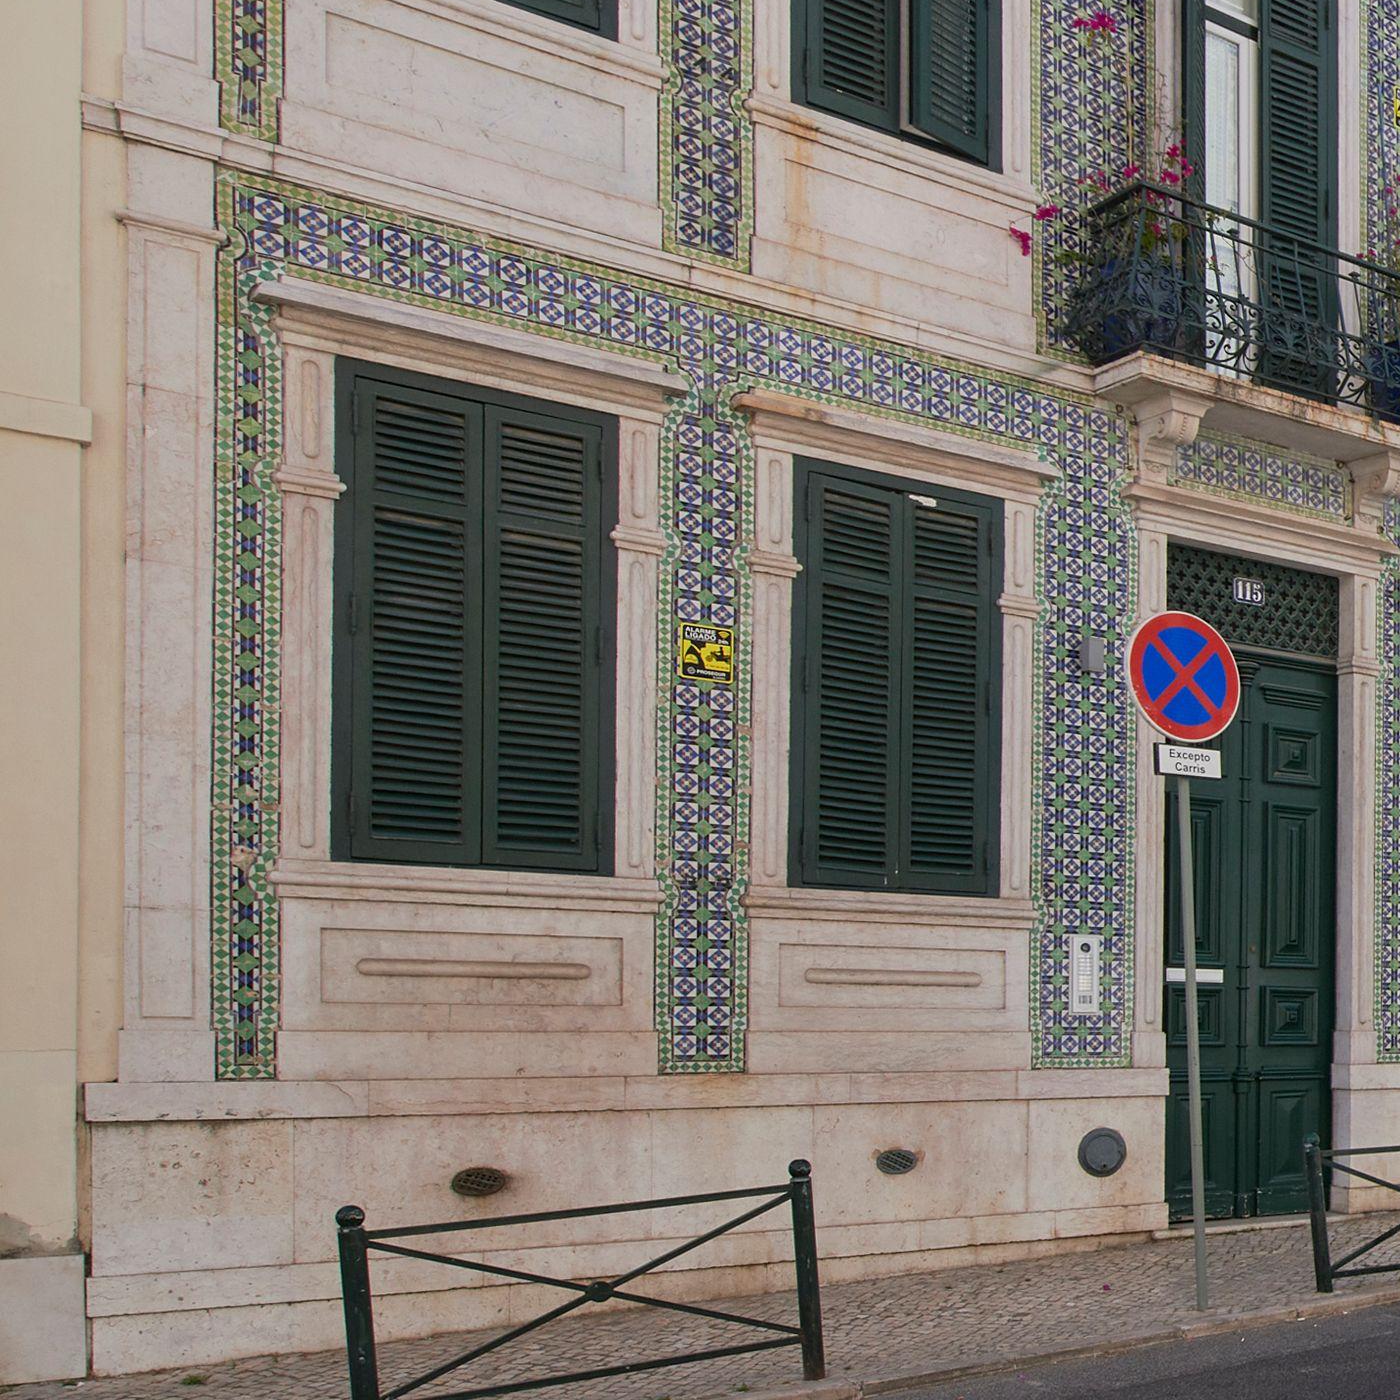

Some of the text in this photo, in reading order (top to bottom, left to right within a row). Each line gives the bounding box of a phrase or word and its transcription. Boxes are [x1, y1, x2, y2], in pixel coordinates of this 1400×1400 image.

[1237, 580, 1262, 603] 115
[685, 626, 716, 636] ALARME
[685, 631, 717, 641] LIGADO
[1169, 748, 1211, 762] Excepto
[1175, 761, 1206, 774] Carris
